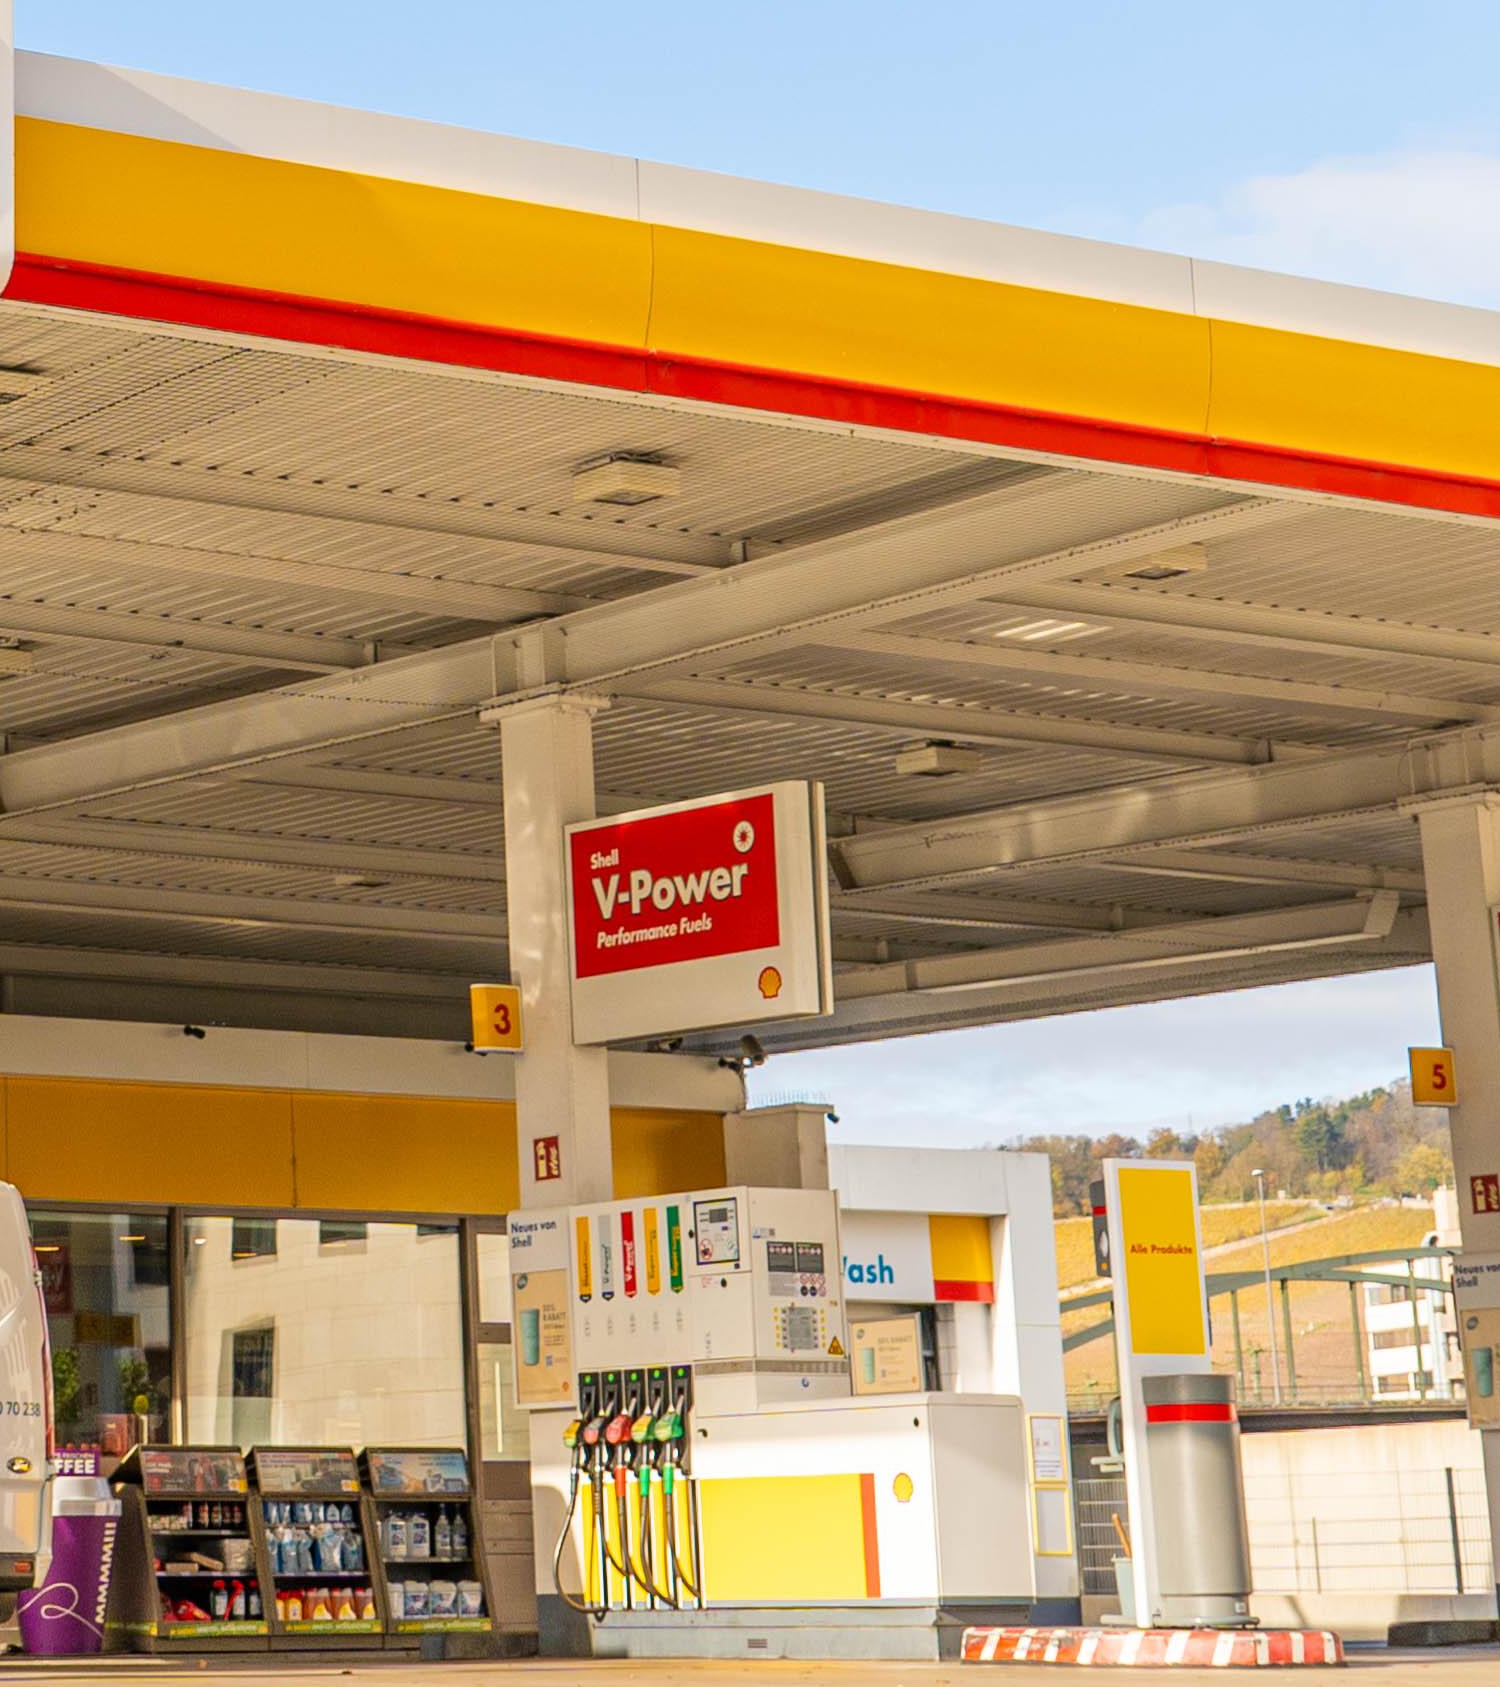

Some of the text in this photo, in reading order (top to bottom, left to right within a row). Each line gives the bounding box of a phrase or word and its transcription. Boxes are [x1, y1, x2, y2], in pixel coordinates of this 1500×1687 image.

[590, 848, 619, 870] Shell
[592, 863, 748, 920] V-Power
[597, 912, 712, 949] Performance Fuels
[493, 1005, 512, 1035] 3
[1431, 1064, 1447, 1089] 5
[511, 1220, 557, 1234] Neues von
[512, 1236, 533, 1249] Shell
[1130, 1244, 1193, 1255] Alle Produkte
[843, 1254, 895, 1284] ash
[1455, 1263, 1484, 1275] Neues
[1456, 1277, 1478, 1288] Shell
[6, 1401, 20, 1416] 70
